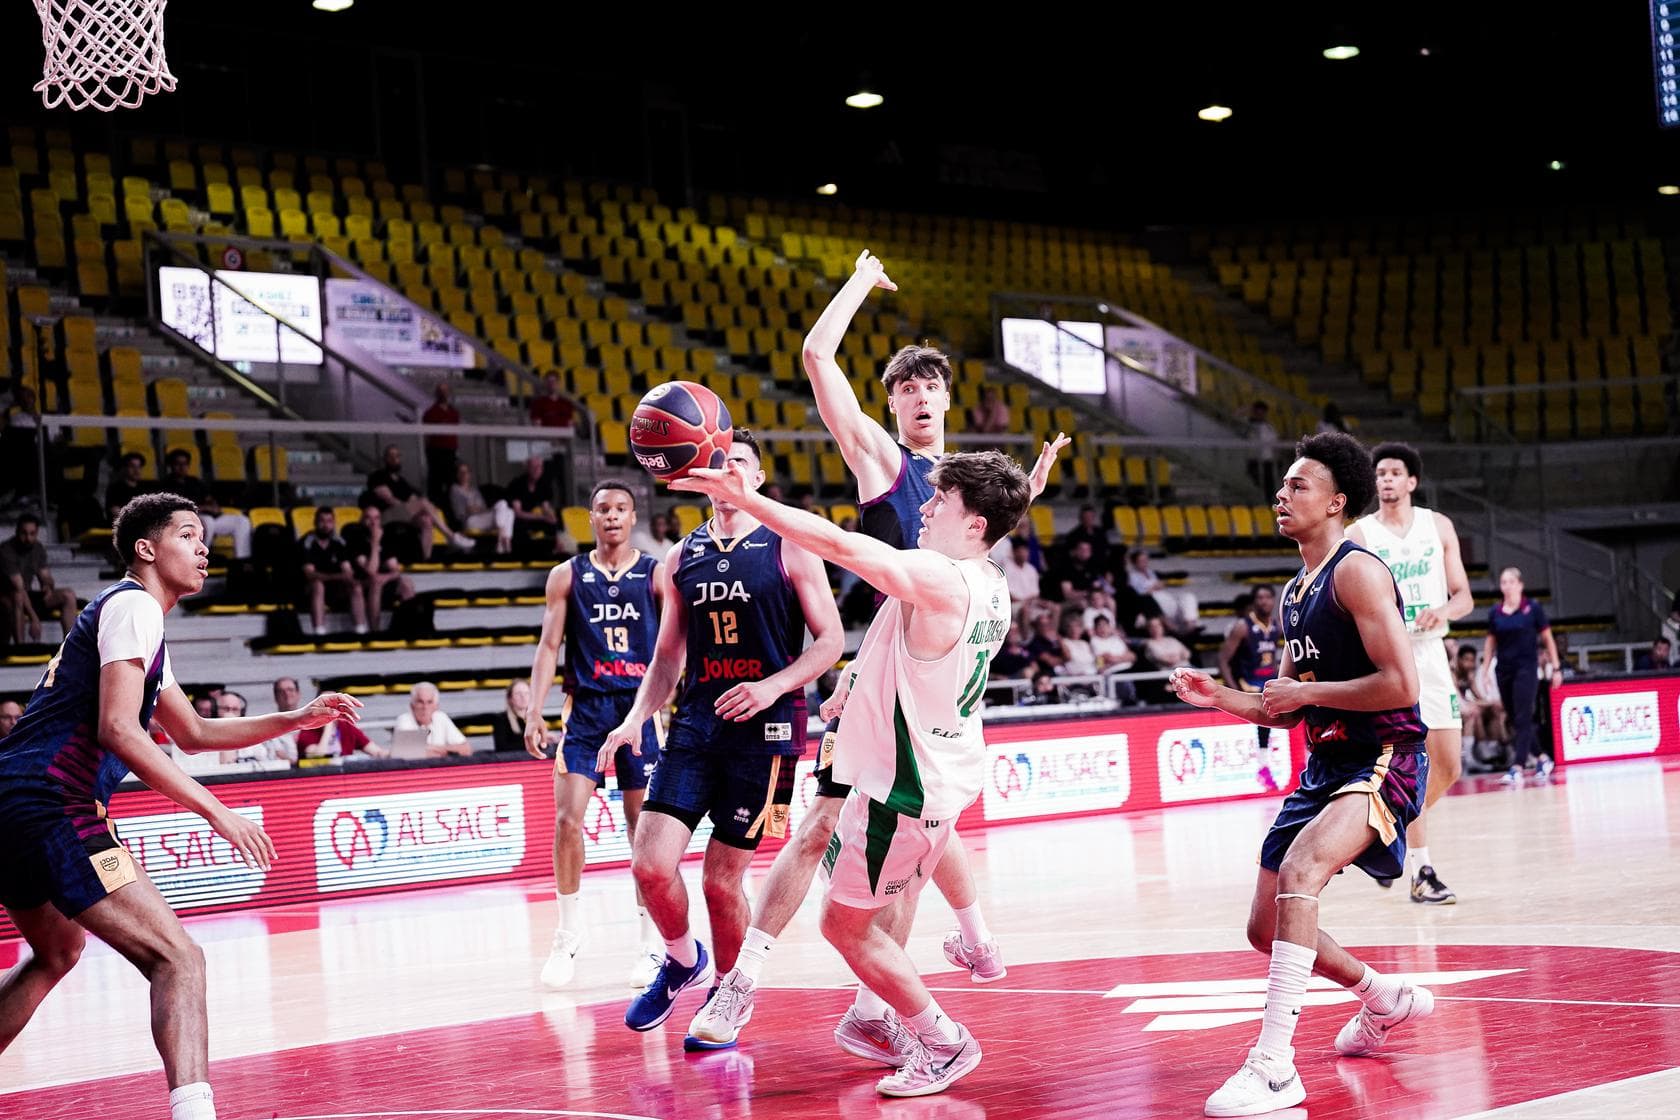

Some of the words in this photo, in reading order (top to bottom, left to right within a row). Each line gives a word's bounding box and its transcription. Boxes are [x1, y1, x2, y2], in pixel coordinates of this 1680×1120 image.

[693, 580, 751, 606] JDA
[590, 603, 640, 623] JDA
[604, 627, 629, 653] 13
[710, 611, 739, 645] 12
[1286, 635, 1320, 662] DA
[1598, 705, 1652, 733] ALSACE
[1212, 736, 1281, 769] ALSAE
[1039, 749, 1118, 785] ALSACE
[397, 803, 512, 847] ALSACE
